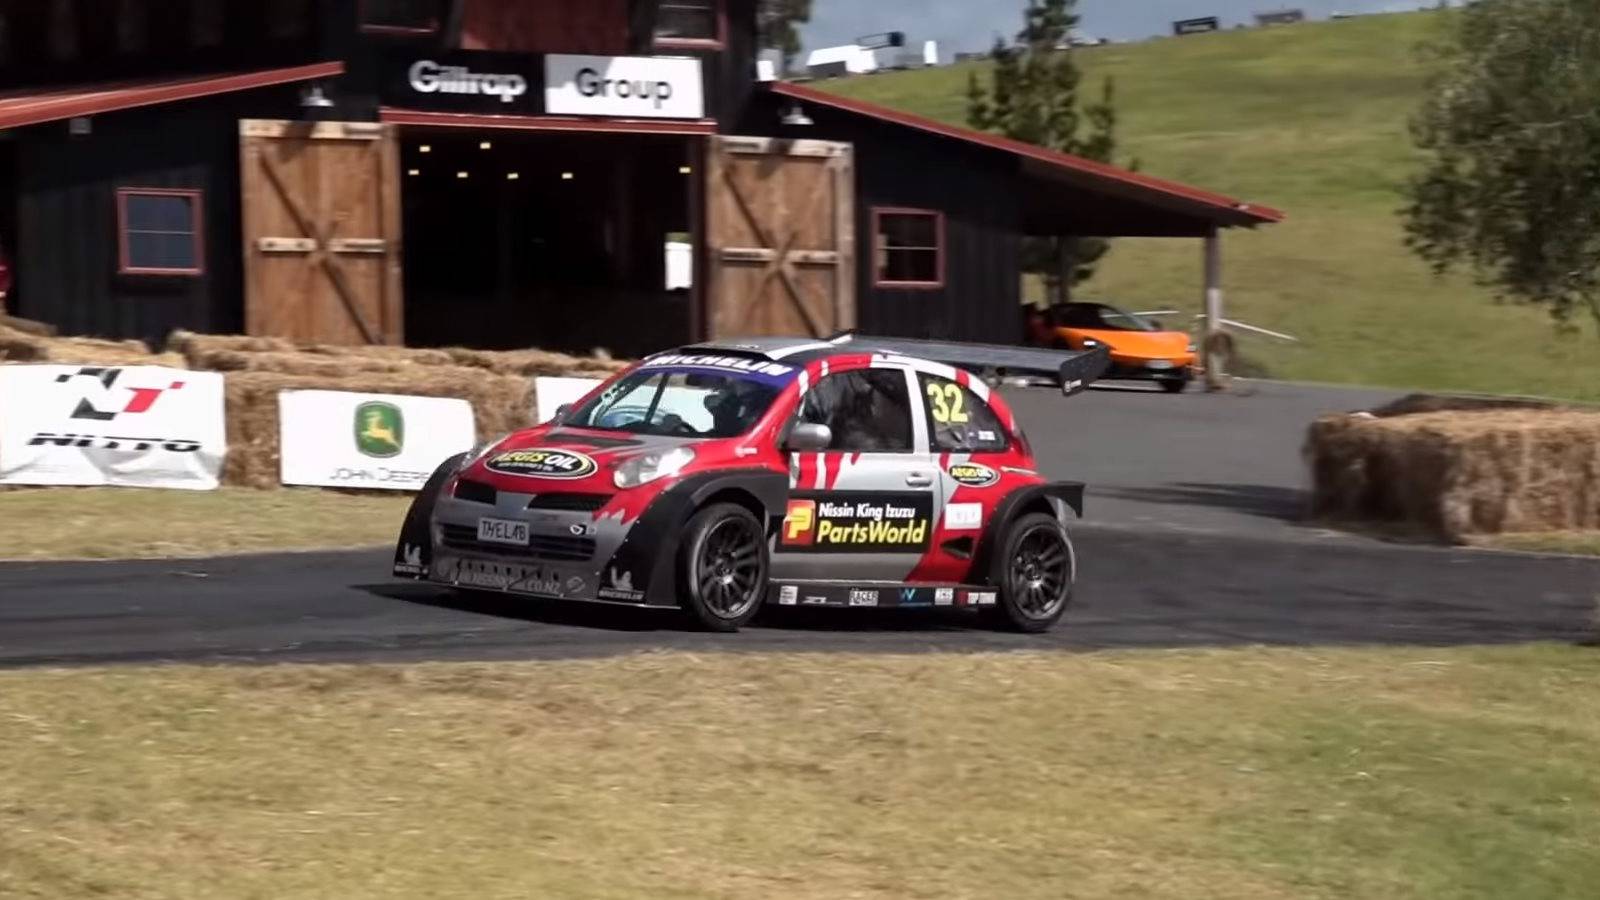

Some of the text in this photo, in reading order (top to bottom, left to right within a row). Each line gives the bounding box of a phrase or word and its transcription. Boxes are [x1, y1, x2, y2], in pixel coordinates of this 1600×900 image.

[575, 67, 673, 109] Group
[644, 354, 794, 377] MICHELIN
[926, 383, 969, 423] 32
[544, 454, 579, 470] OIL
[818, 502, 916, 521] Nissin King Izuzu
[816, 519, 927, 544] PartsWorld
